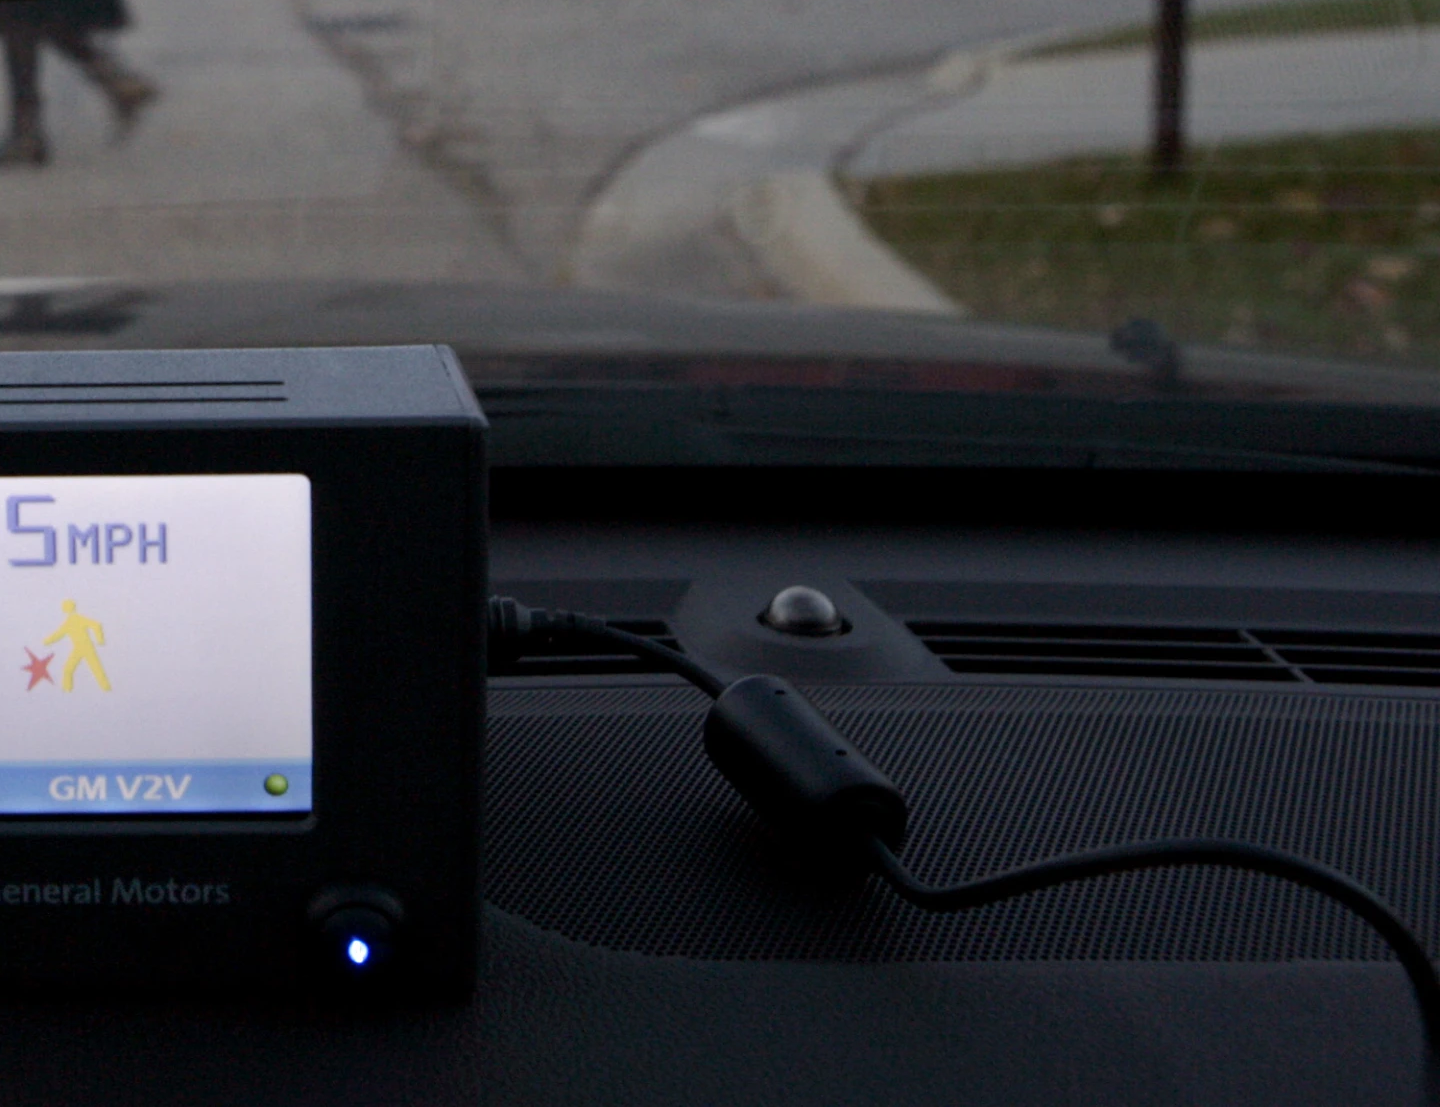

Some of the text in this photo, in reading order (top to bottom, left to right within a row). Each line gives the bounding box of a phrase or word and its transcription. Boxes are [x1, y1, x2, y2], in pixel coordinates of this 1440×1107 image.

[48, 774, 193, 802] GM V2V
[110, 876, 232, 906] Motors
